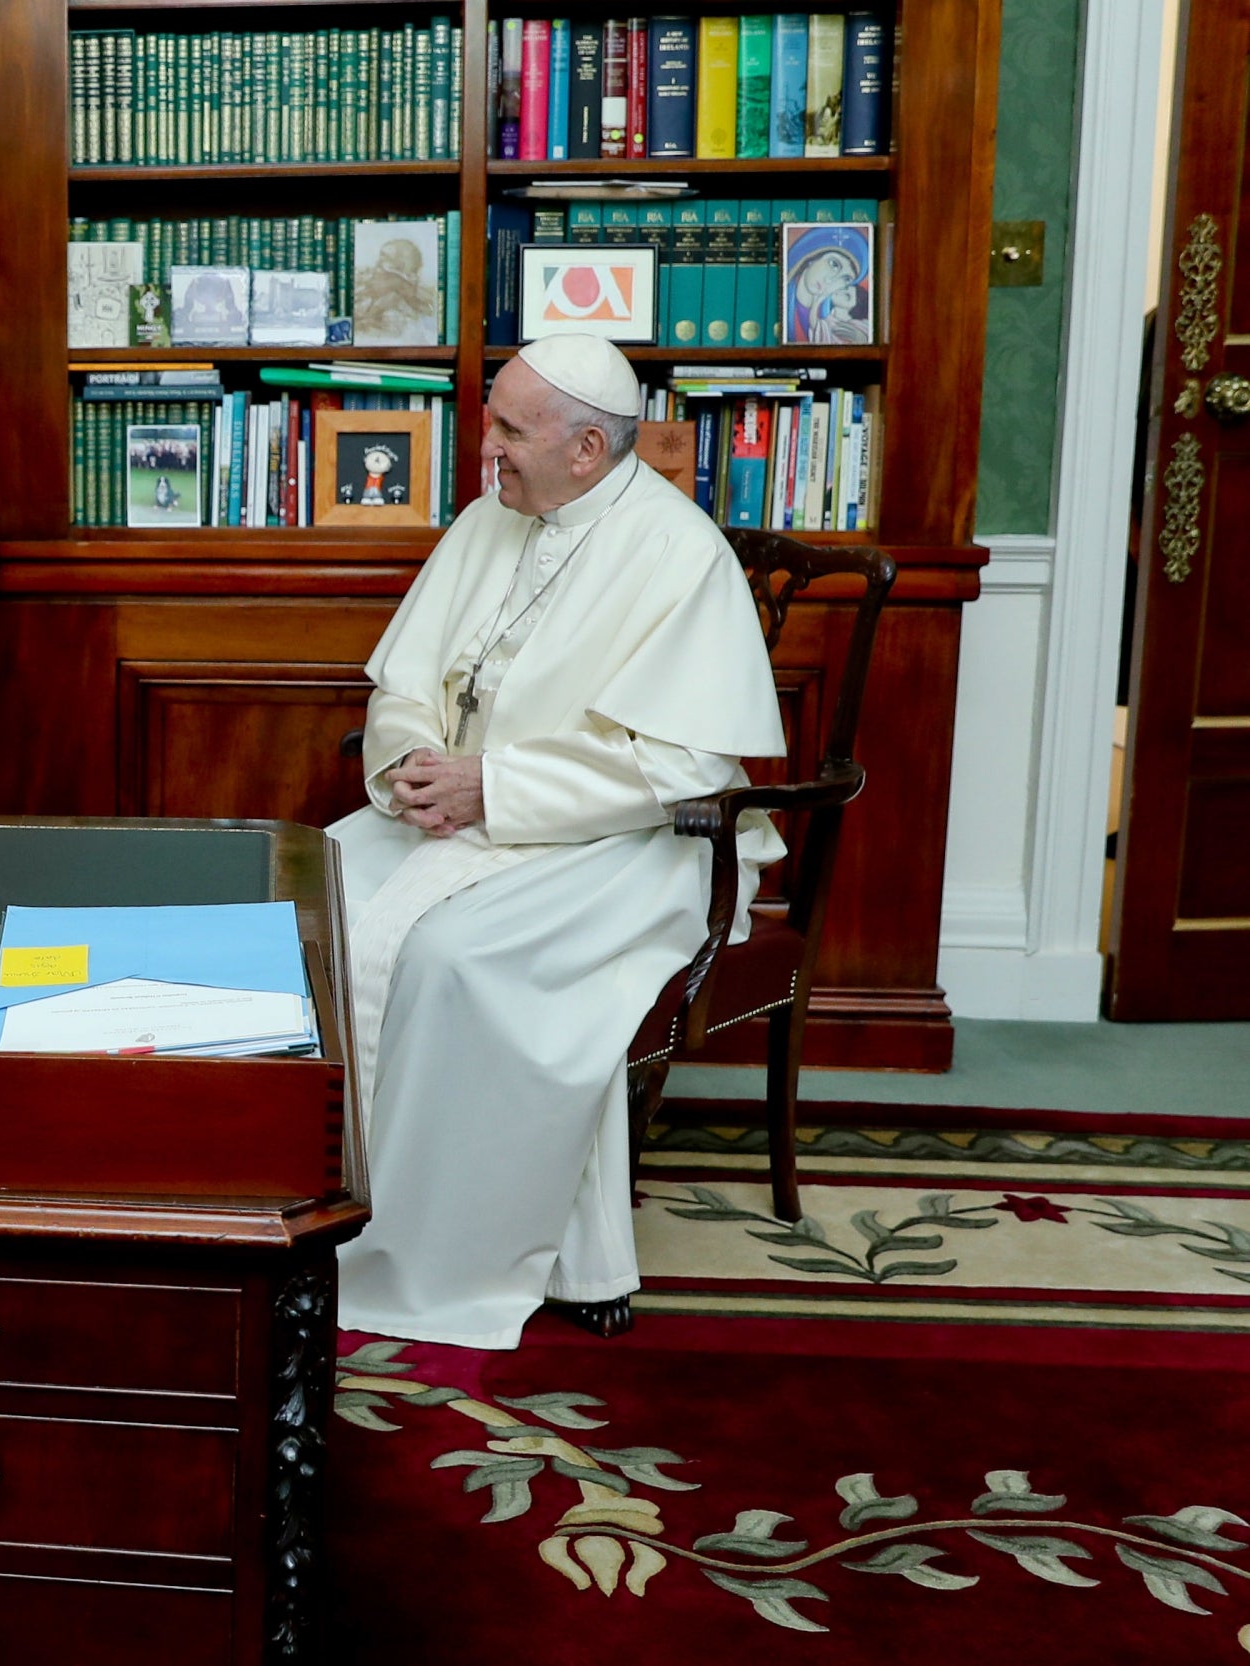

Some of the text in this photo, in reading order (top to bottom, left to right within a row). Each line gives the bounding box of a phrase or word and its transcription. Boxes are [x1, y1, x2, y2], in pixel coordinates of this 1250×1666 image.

[578, 212, 594, 223] RIA
[612, 212, 629, 223] RIA
[646, 212, 663, 223] RIA
[681, 211, 698, 222] RIA
[714, 211, 731, 222] RIA
[746, 210, 763, 222] RIA
[859, 427, 869, 466] VOYAGE
[231, 421, 243, 499] DUBLINERS
